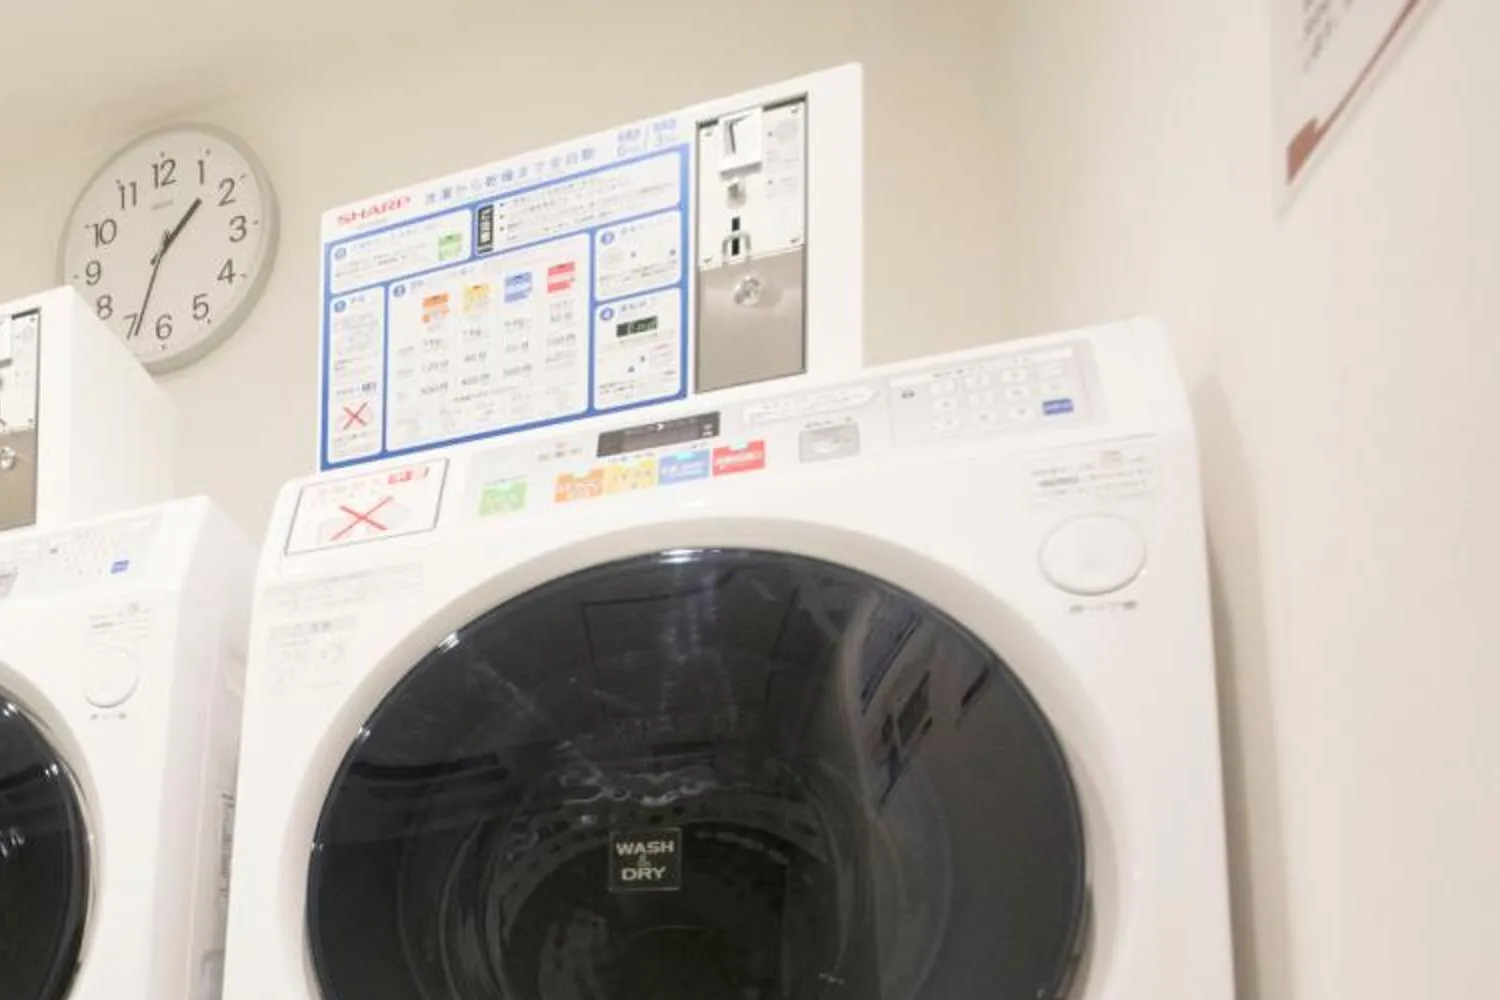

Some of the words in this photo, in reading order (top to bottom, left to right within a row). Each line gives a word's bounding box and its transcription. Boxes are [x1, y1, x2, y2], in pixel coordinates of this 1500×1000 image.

[151, 158, 177, 189] 12
[197, 159, 205, 185] 1
[118, 181, 138, 210] 11
[218, 178, 236, 206] 2
[337, 195, 412, 225] SHARP
[92, 218, 118, 248] 10
[228, 215, 247, 243] 3
[85, 259, 102, 286] 9
[217, 258, 237, 285] 4
[96, 294, 114, 321] 8
[192, 293, 209, 321] 5
[124, 313, 139, 340] 7
[155, 314, 173, 340] 6
[615, 840, 675, 857] WASH
[621, 866, 667, 881] DRY
